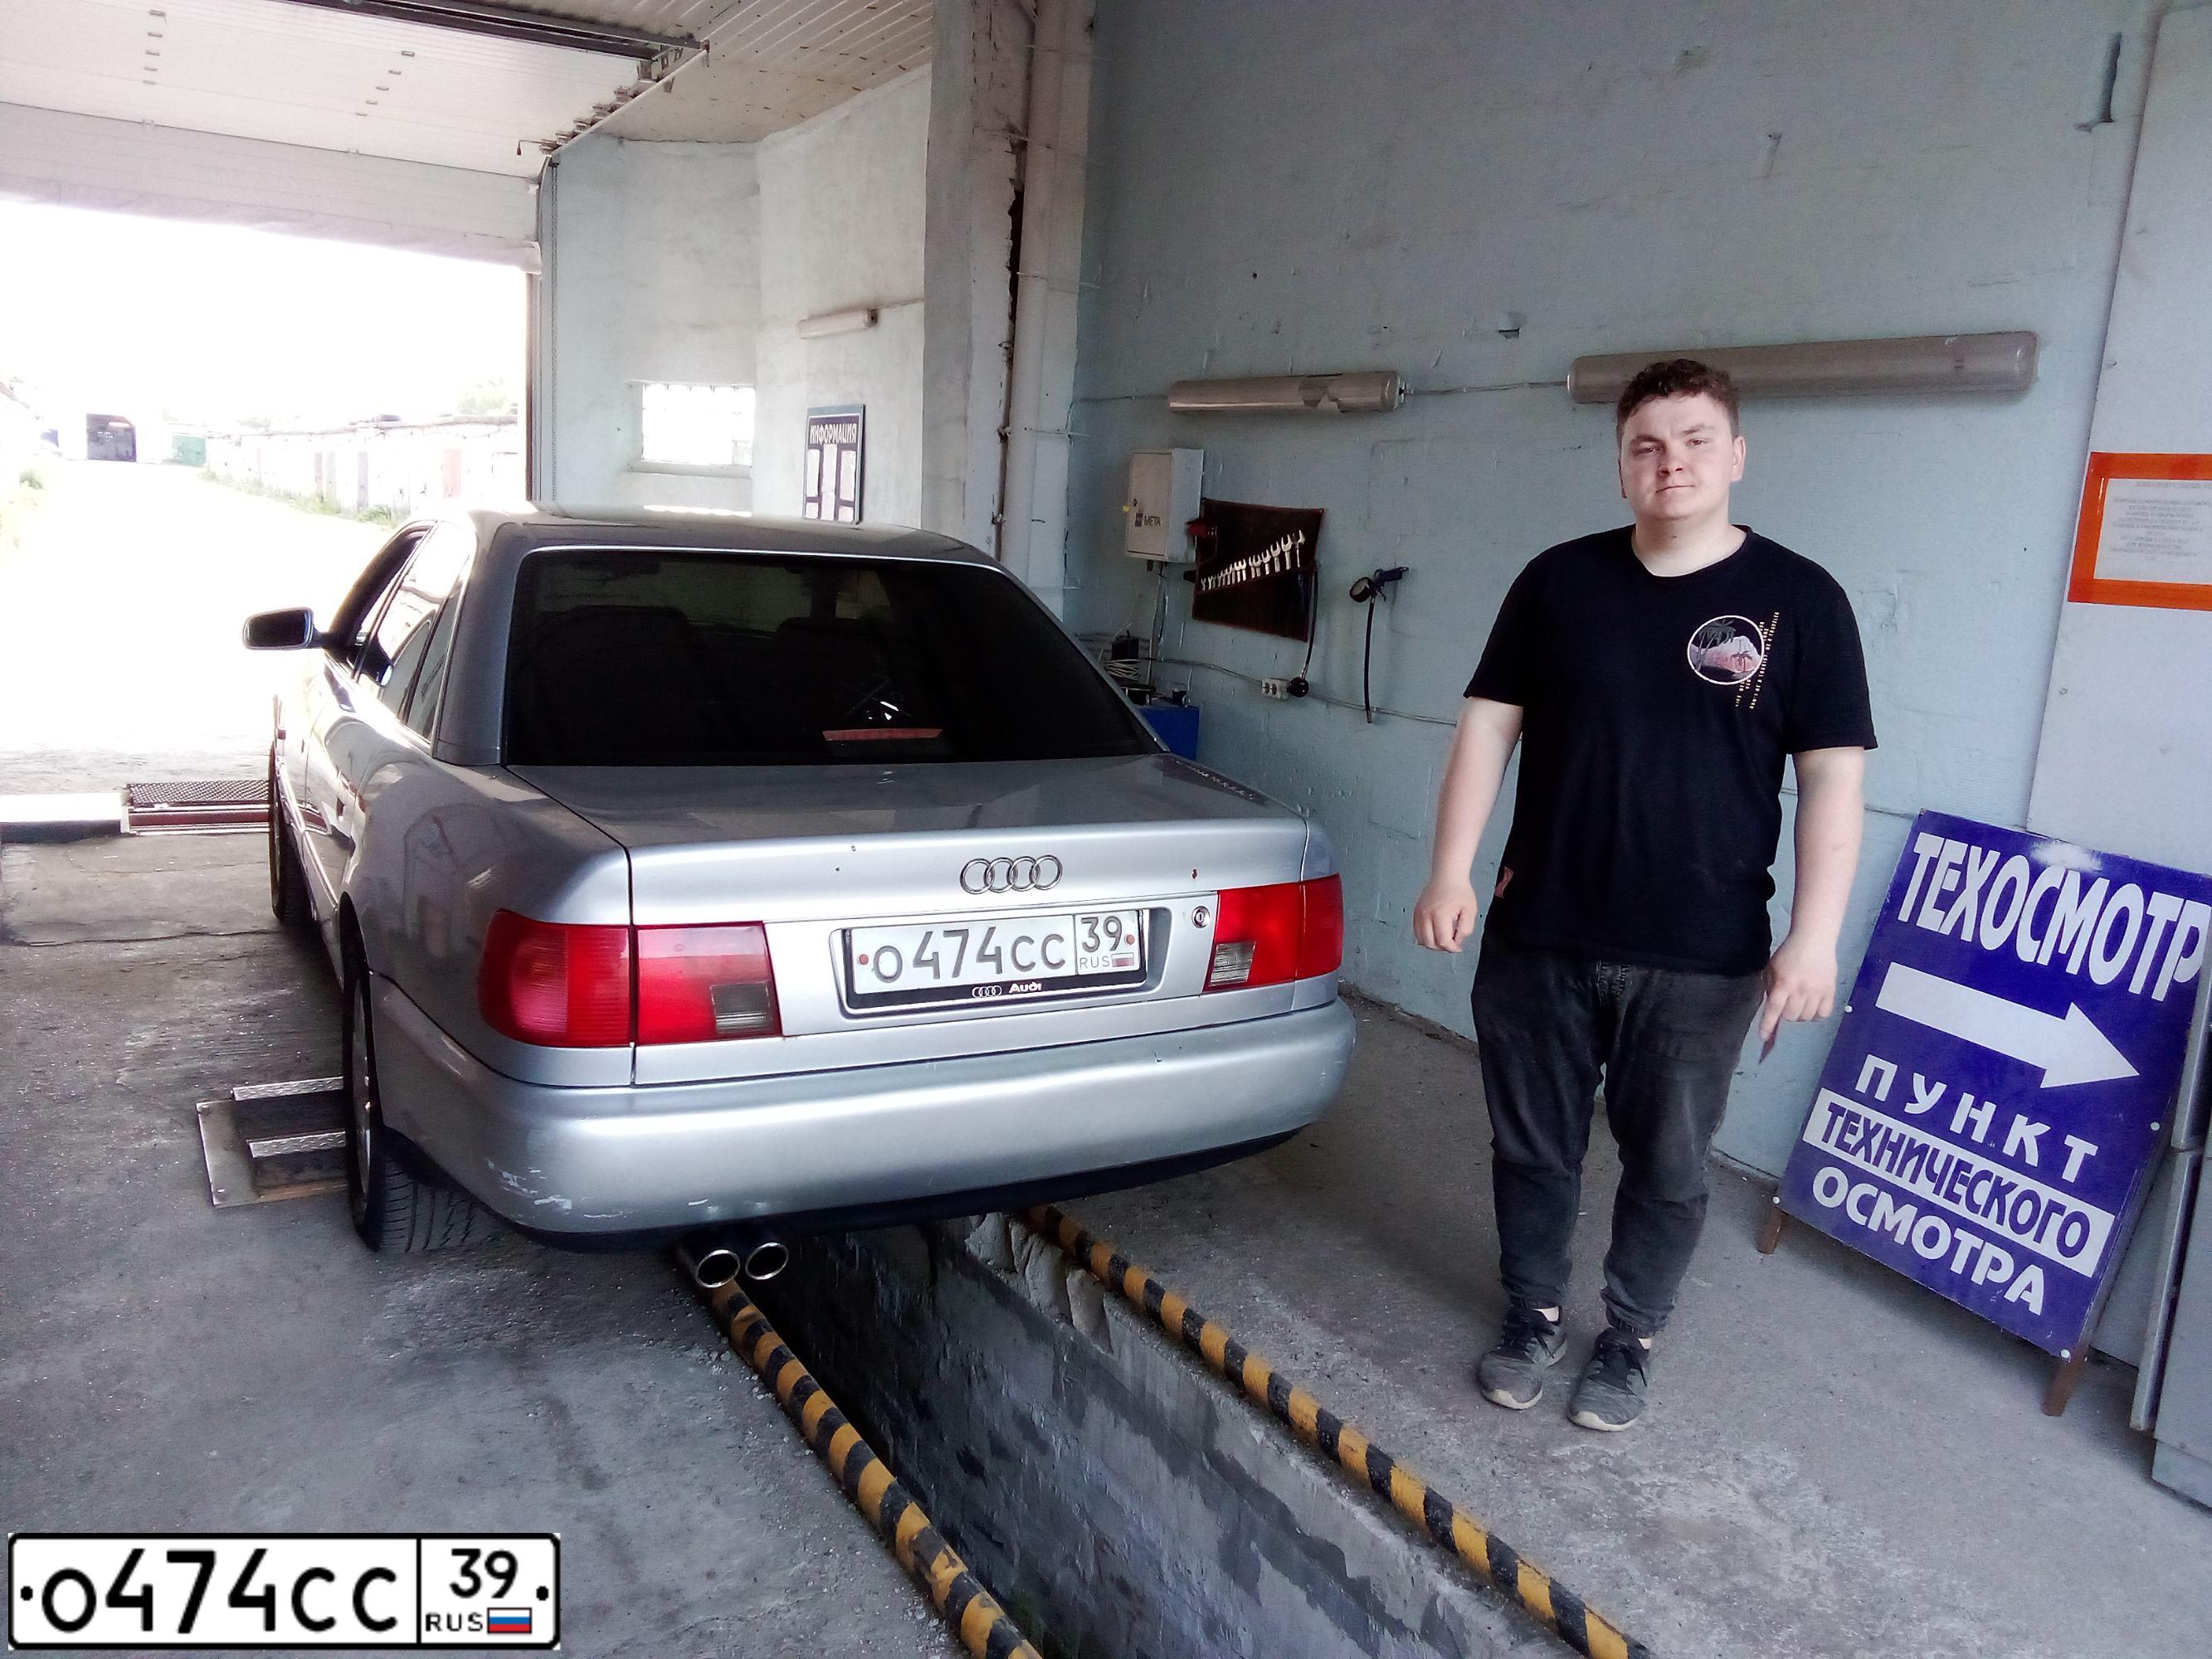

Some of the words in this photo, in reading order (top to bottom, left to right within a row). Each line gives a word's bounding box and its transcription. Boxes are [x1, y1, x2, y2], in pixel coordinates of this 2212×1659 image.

[810, 423, 857, 445] ИНФОРМАЦИЯ
[1080, 915, 1123, 953] 39
[1898, 832, 2212, 1002] ТЕХОСМОТР
[1009, 981, 1042, 994] Audi
[1079, 956, 1111, 969] RUS
[1854, 1053, 2098, 1183] ПУНКТ
[1820, 1101, 2092, 1258] ТЕХНИЧЕСКОГО
[1812, 1165, 2044, 1316] ОСМОТРА
